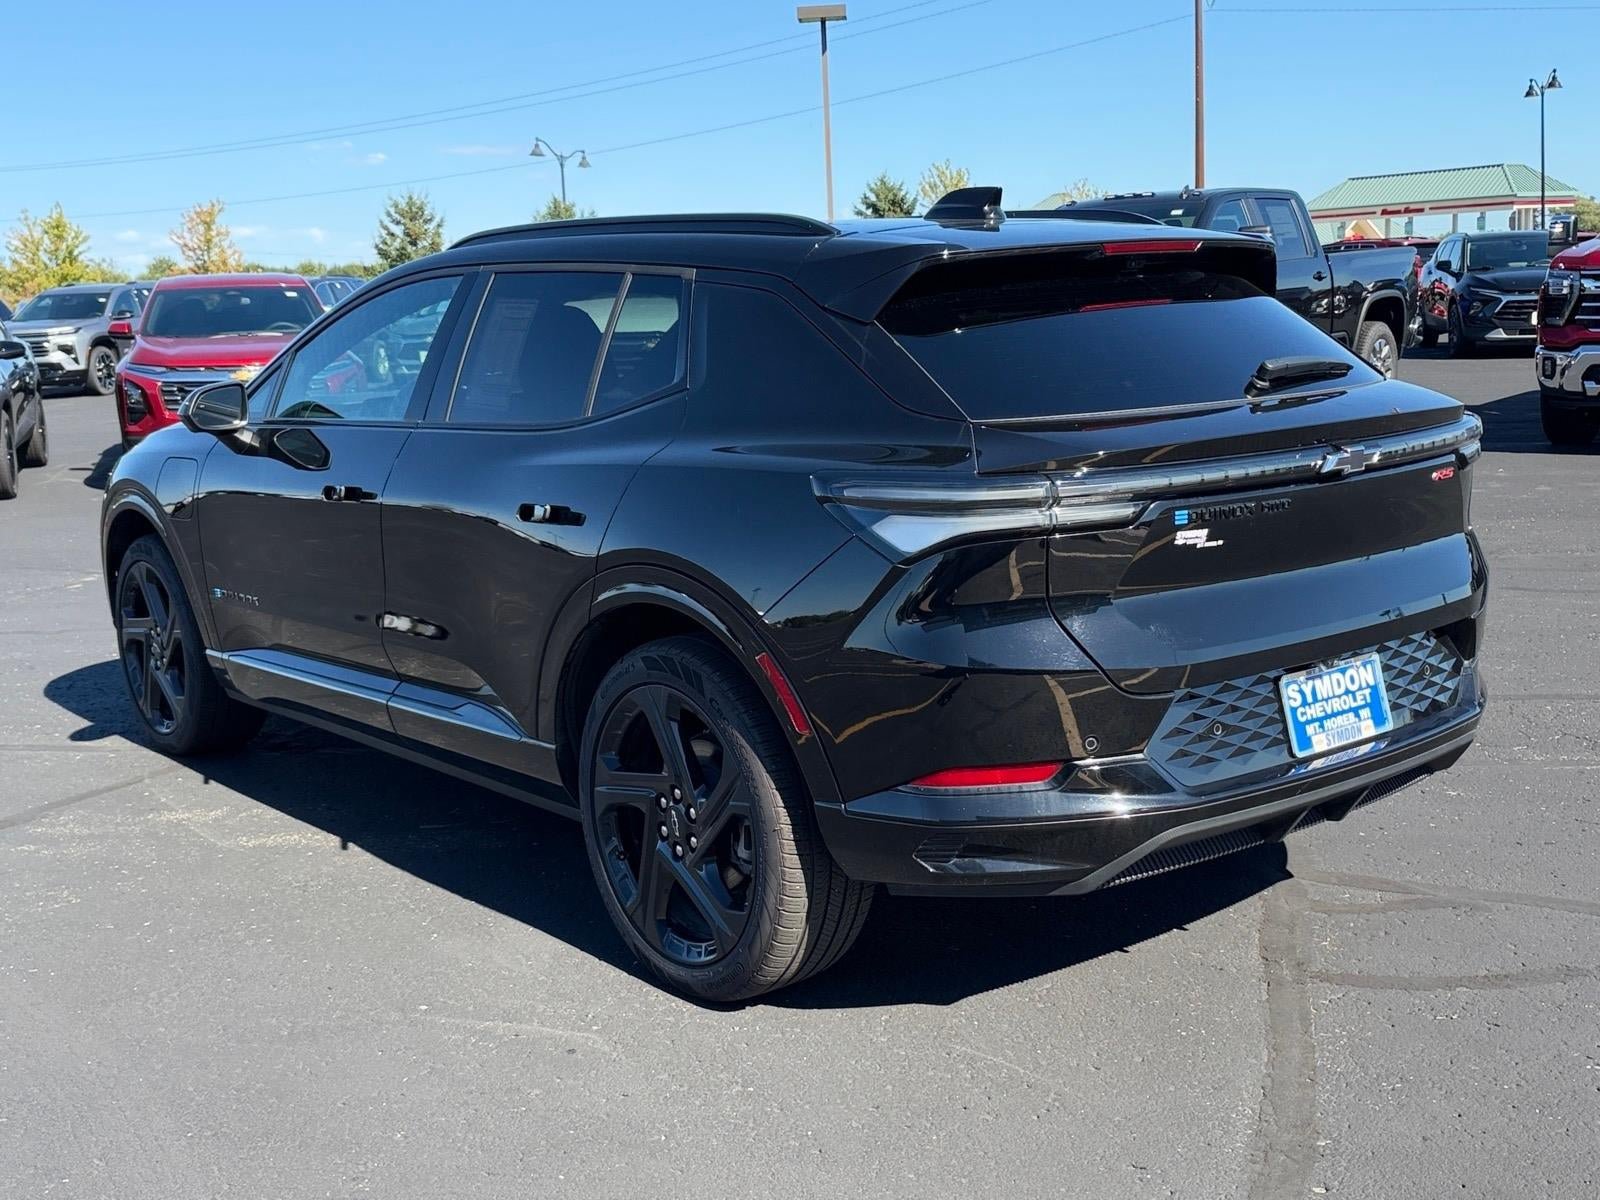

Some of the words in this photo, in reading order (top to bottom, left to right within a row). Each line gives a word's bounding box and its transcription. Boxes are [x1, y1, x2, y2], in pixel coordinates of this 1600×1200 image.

[1434, 466, 1454, 480] RS
[1286, 663, 1375, 708] SYMDON
[1296, 688, 1372, 722] CHEVROLET
[1325, 723, 1362, 747] SYMDON
